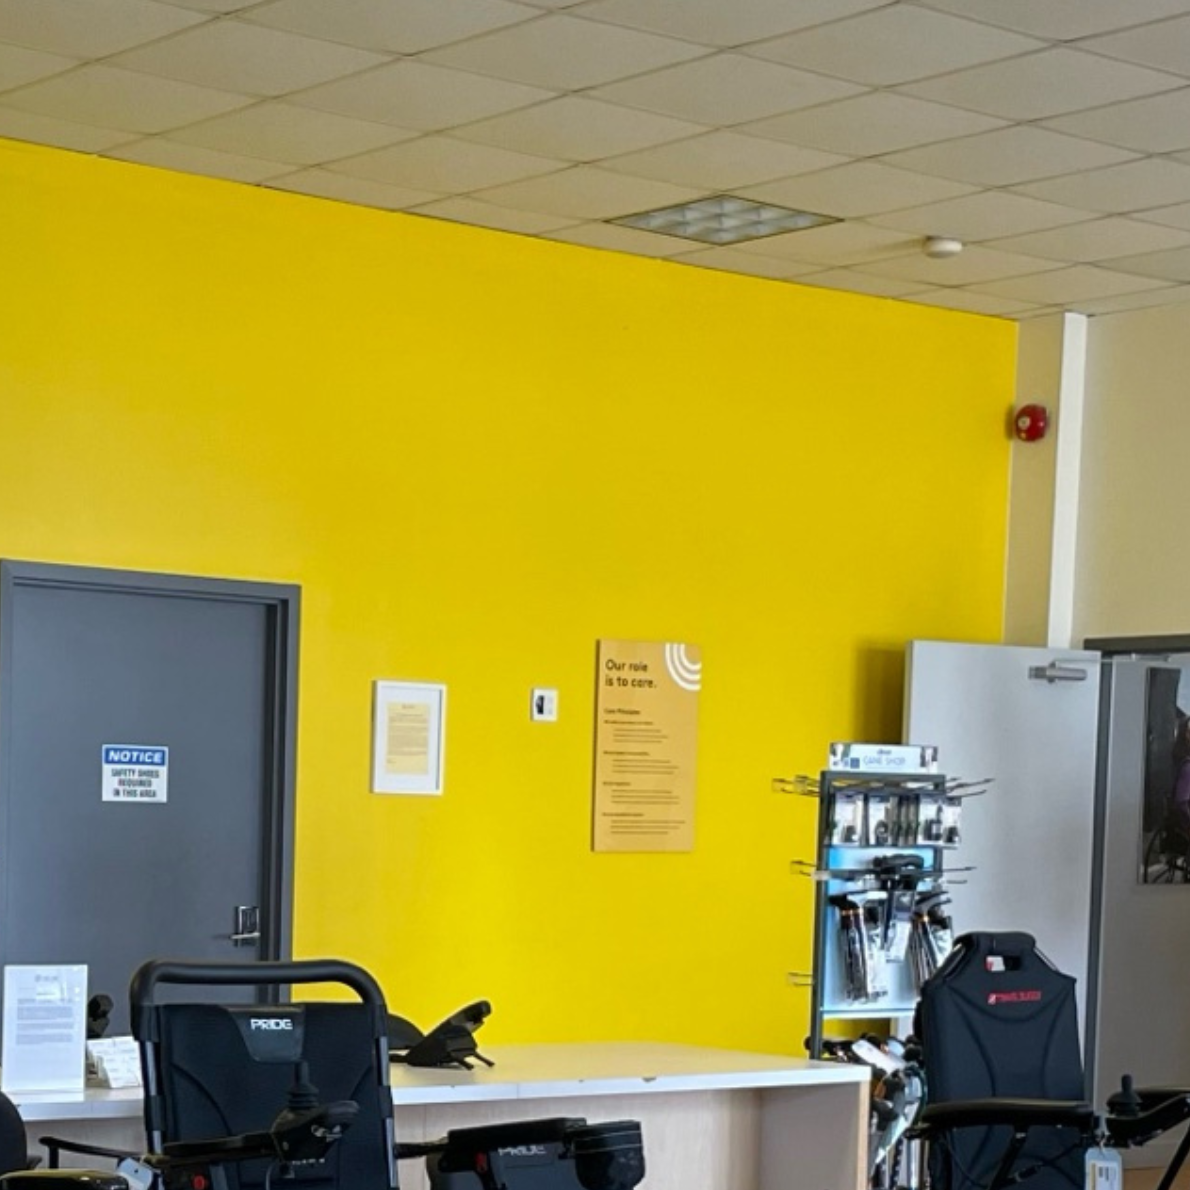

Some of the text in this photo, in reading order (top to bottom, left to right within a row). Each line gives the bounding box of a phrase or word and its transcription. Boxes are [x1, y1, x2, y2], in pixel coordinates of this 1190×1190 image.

[605, 659, 649, 673] Our role
[605, 674, 658, 689] is to care.
[108, 750, 164, 764] NOTICE
[111, 768, 137, 778] SAFETY
[113, 788, 157, 798] IN THIS AREA
[250, 1018, 293, 1030] PRIDE
